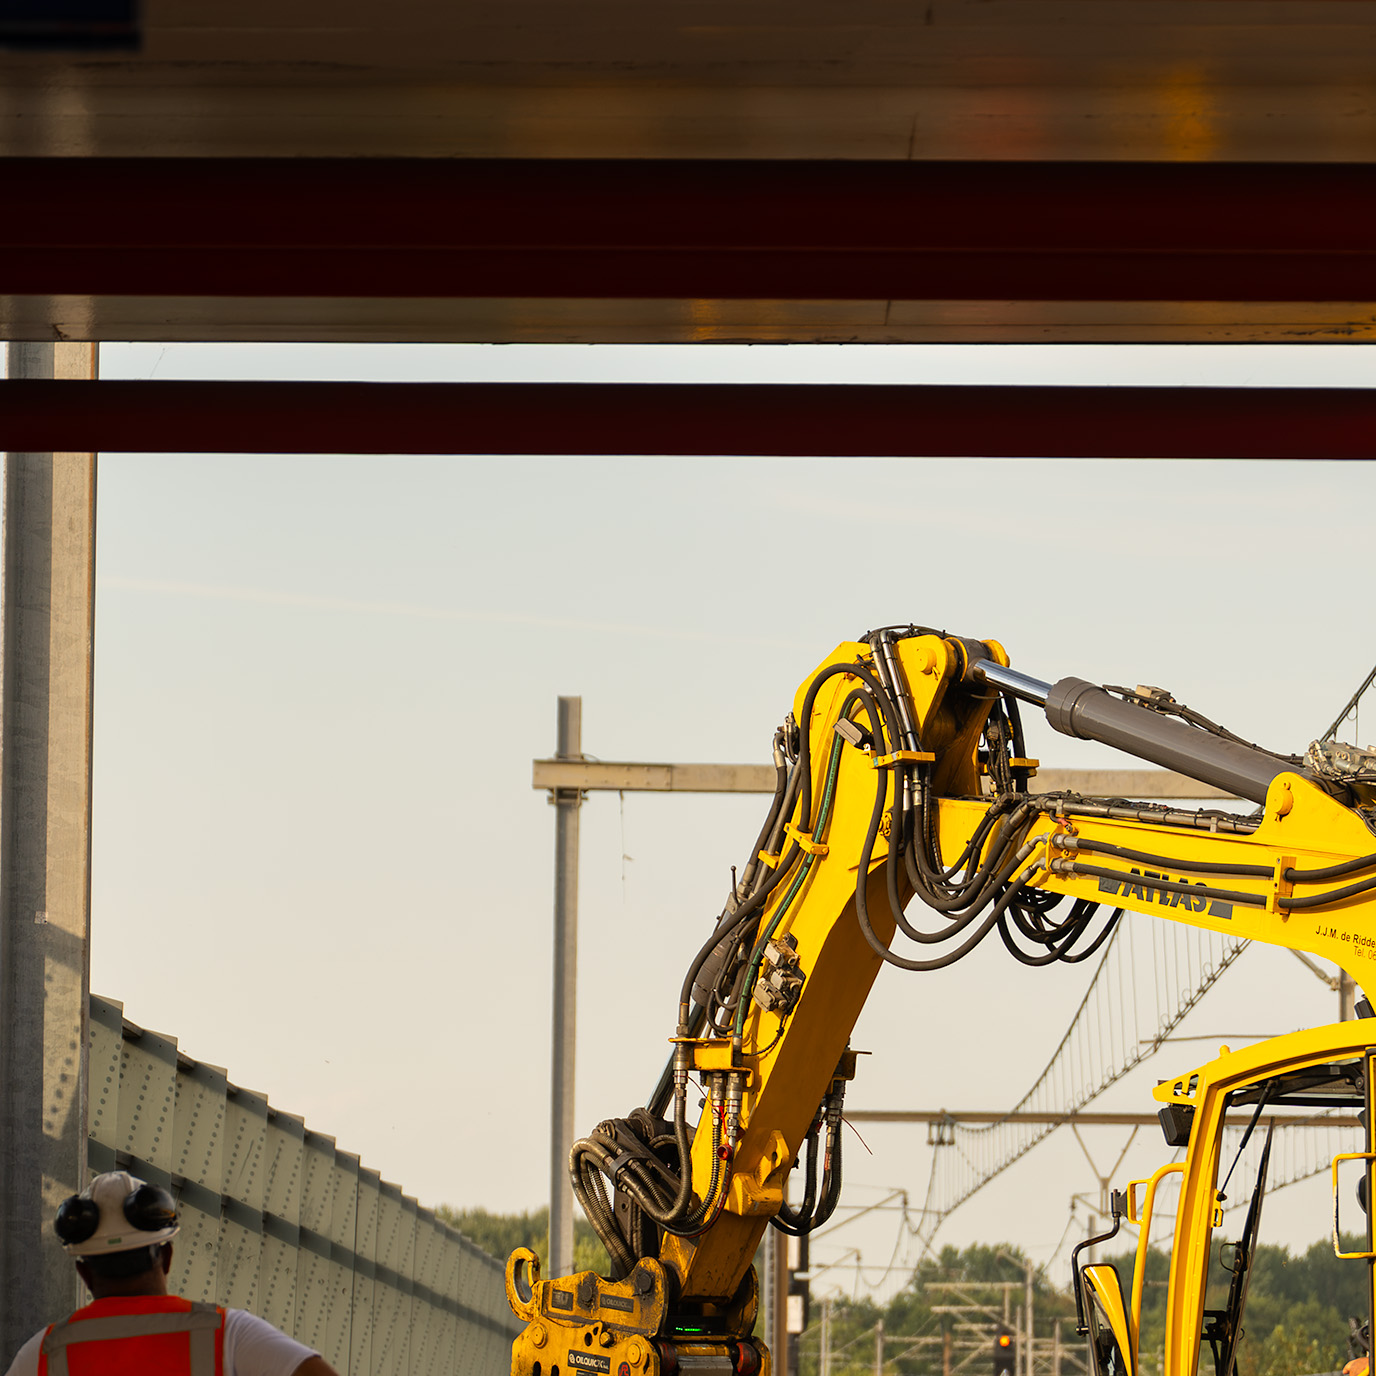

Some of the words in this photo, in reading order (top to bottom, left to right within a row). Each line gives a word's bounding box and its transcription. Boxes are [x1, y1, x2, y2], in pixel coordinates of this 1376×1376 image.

[1121, 867, 1208, 913] ATLAS
[1315, 925, 1339, 940] J.J.M.
[1340, 931, 1351, 942] de
[1353, 945, 1366, 958] Tel.
